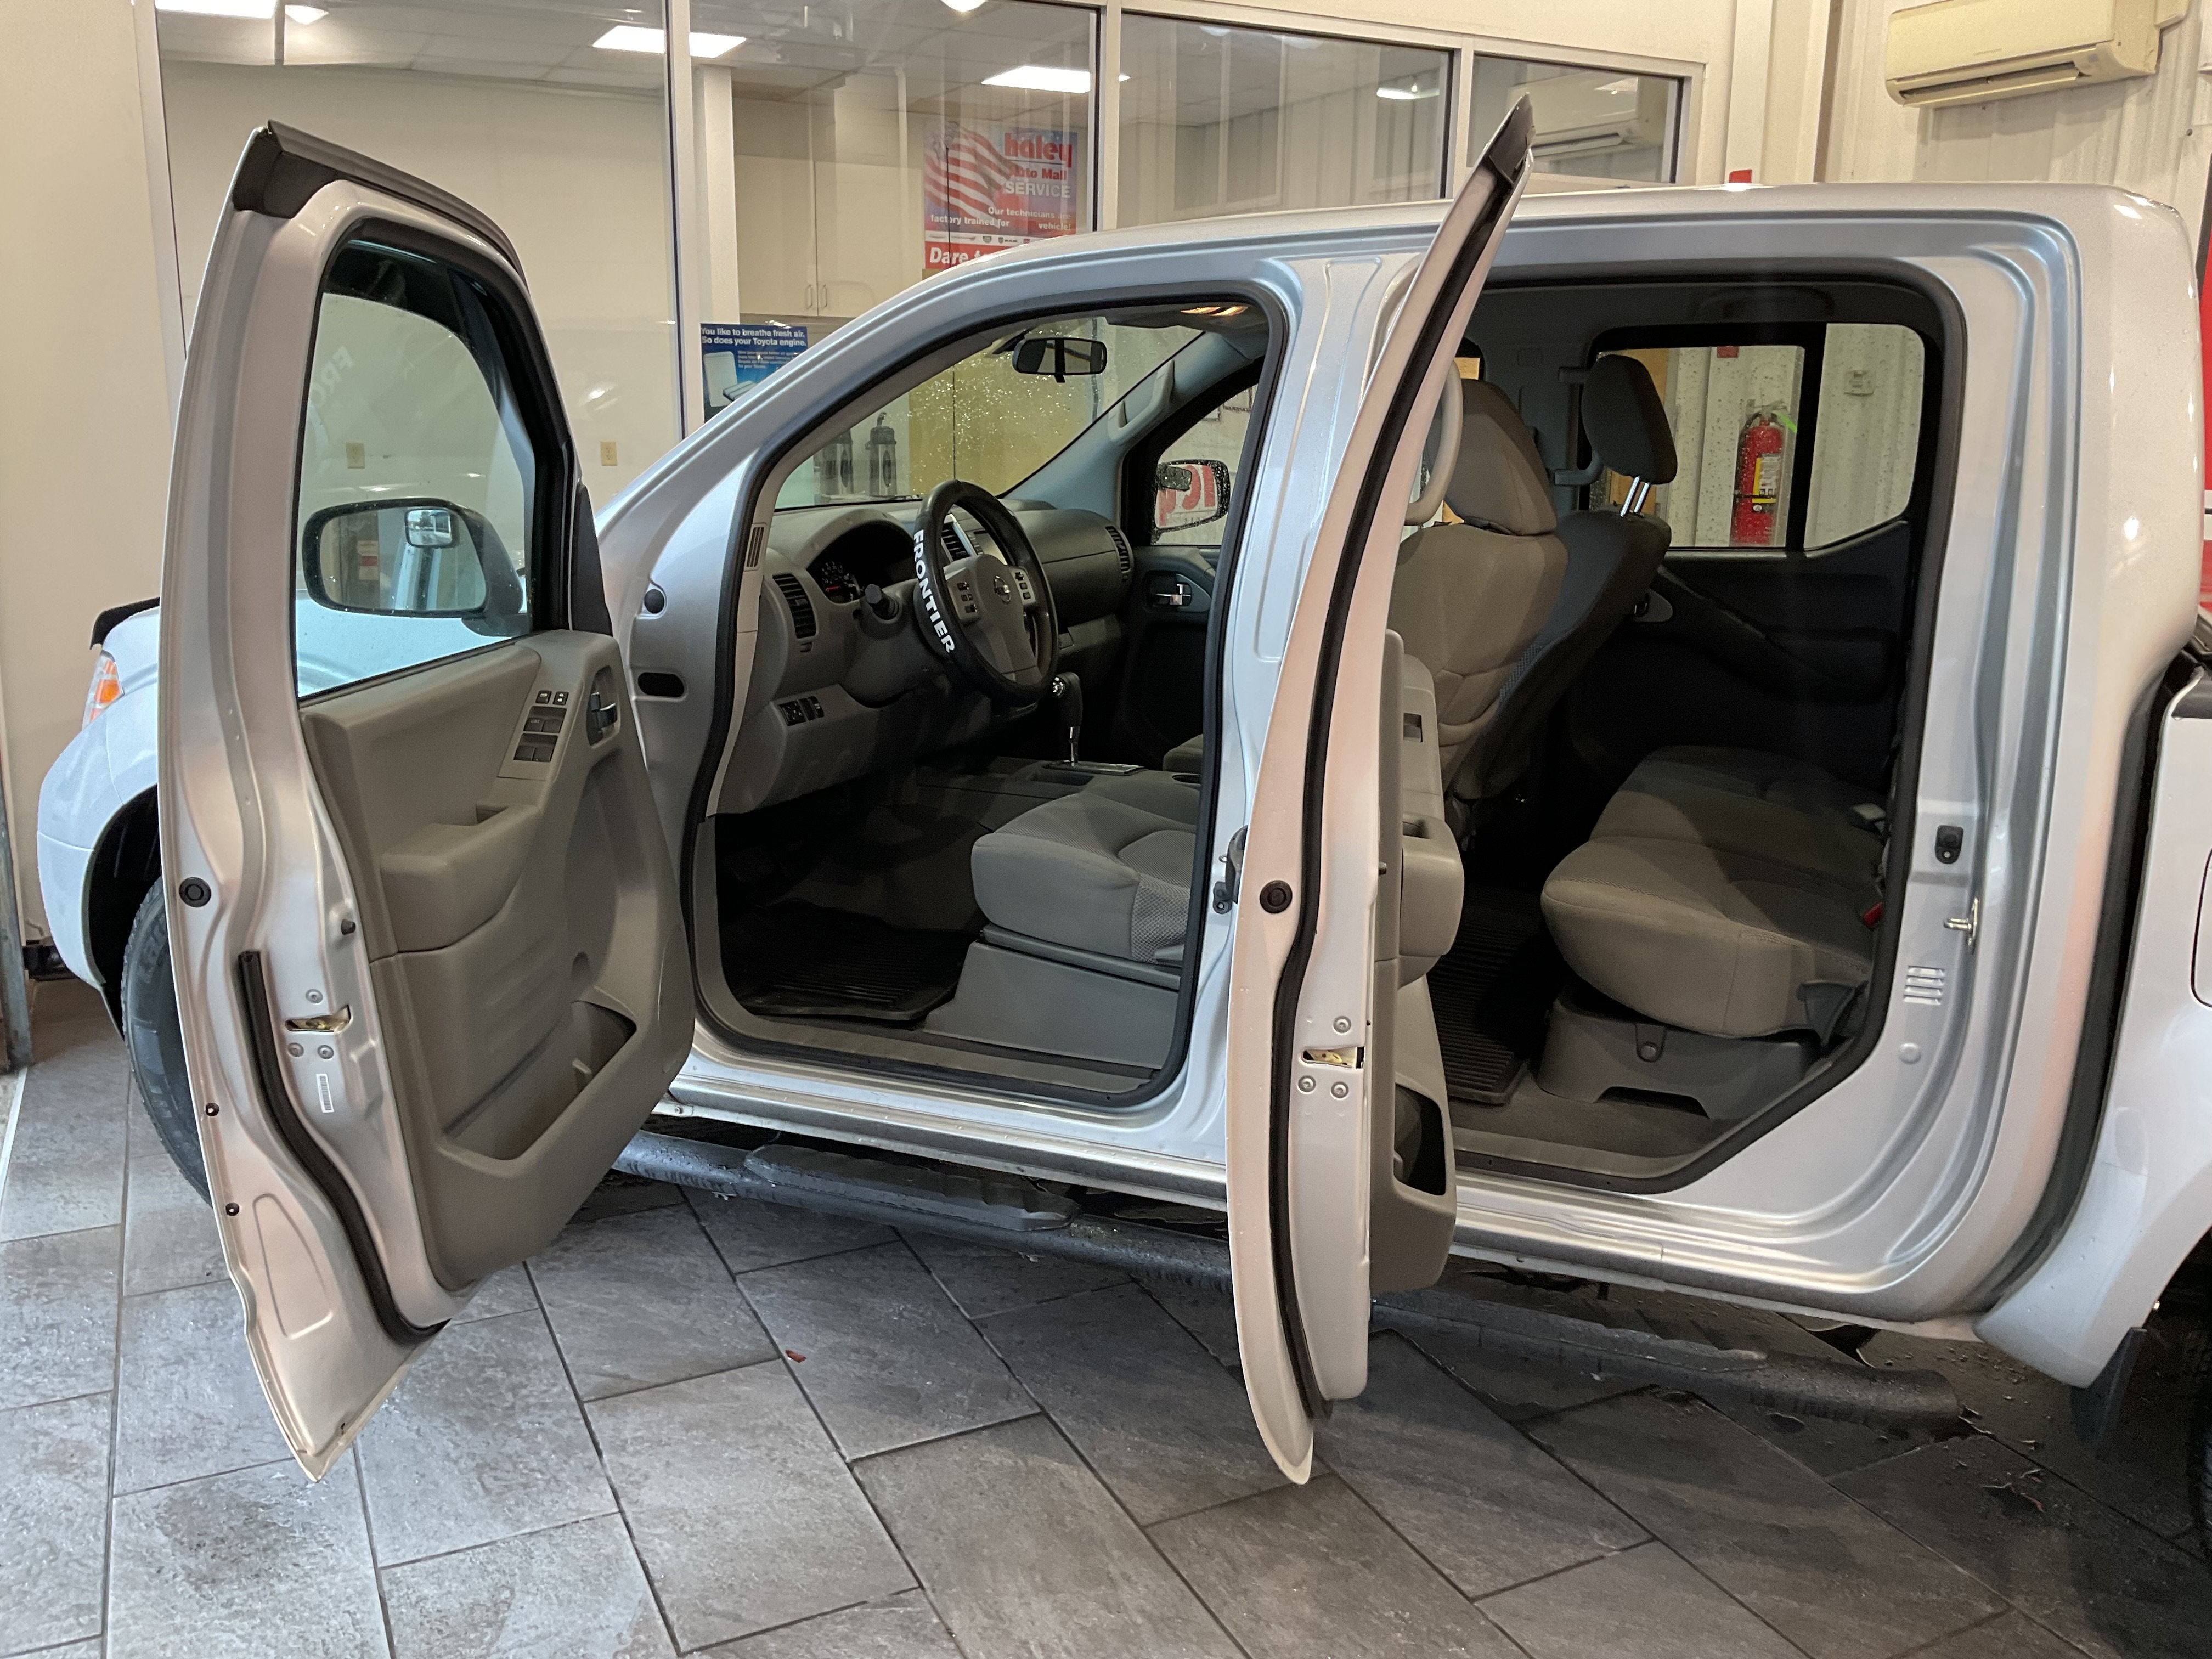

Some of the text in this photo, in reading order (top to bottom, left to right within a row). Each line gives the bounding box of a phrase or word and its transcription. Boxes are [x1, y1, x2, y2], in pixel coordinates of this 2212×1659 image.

[1005, 132, 1072, 168] haley
[1041, 168, 1067, 180] Mall
[1004, 180, 1071, 198] SERVICE
[1006, 208, 1055, 219] technicians
[930, 214, 962, 225] factory
[964, 216, 995, 226] trained
[997, 218, 1011, 227] for
[929, 247, 969, 264] Dare
[772, 329, 792, 337] fresh
[701, 336, 713, 344] So
[734, 338, 752, 346] your
[753, 337, 778, 347] Toyota
[779, 338, 807, 347] engine.
[913, 529, 955, 654] FRONTIER
